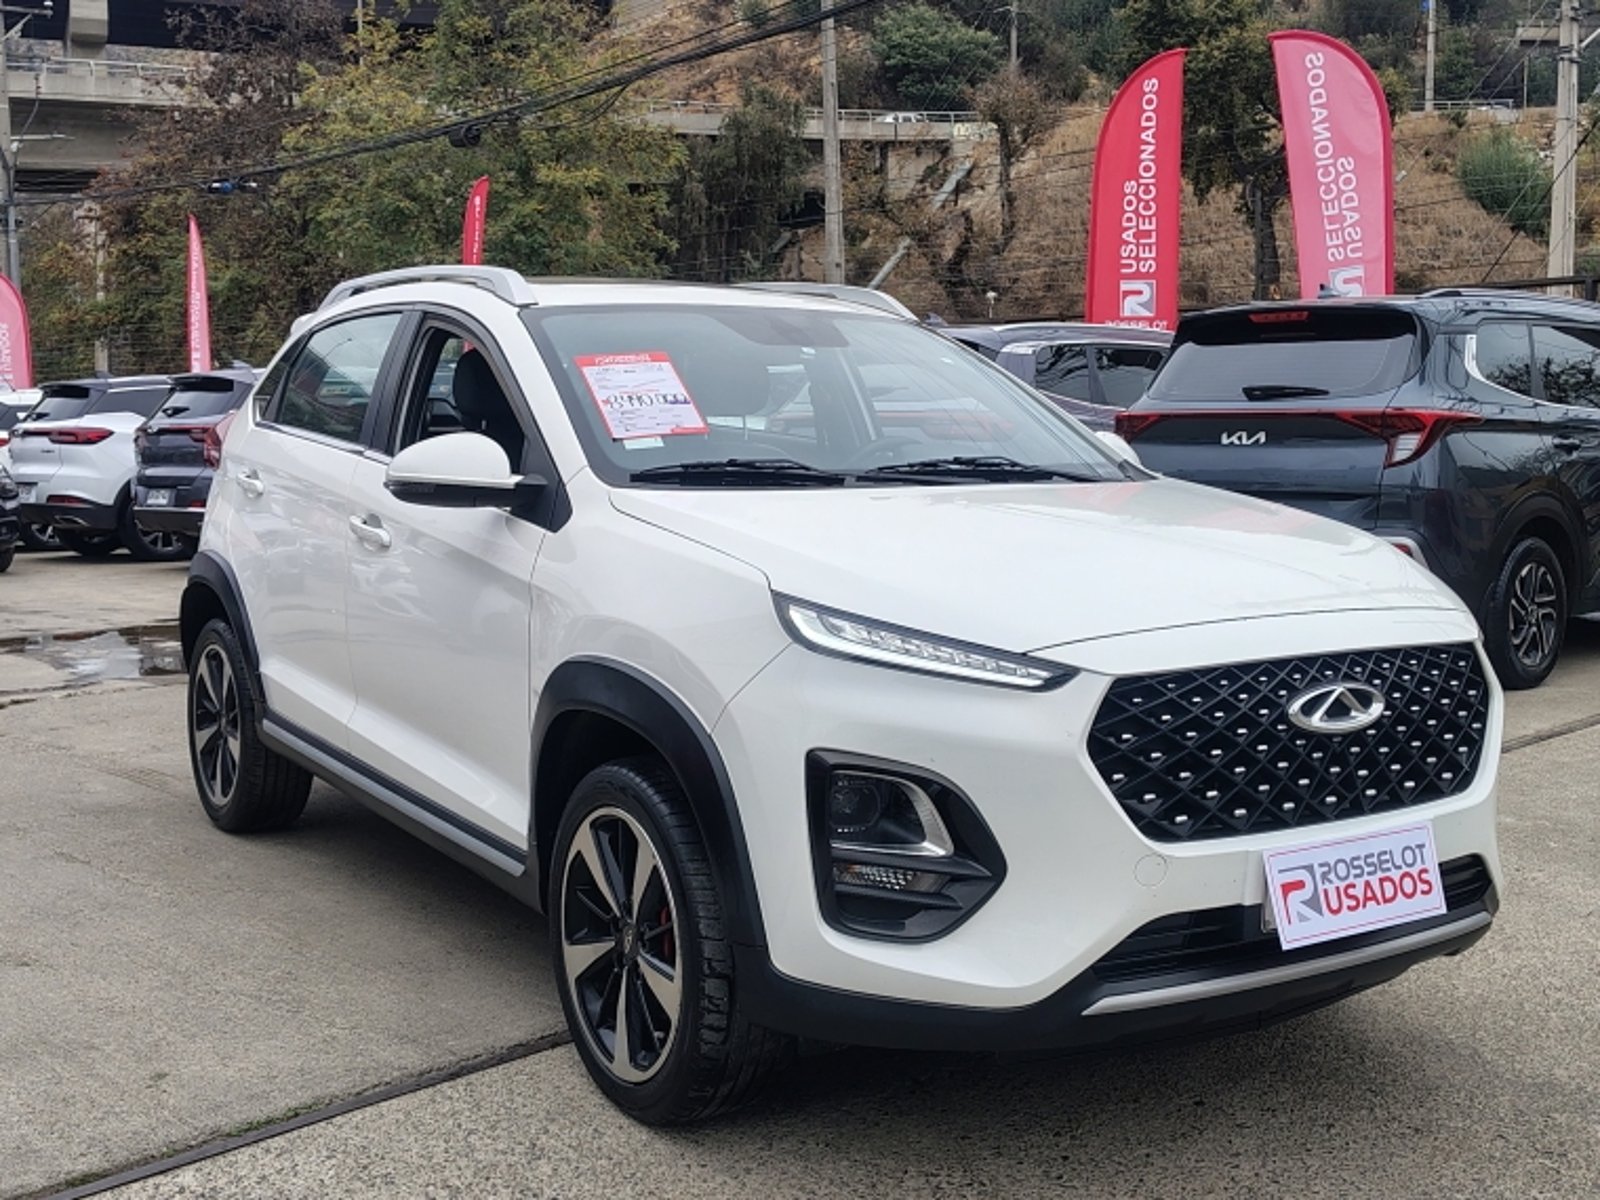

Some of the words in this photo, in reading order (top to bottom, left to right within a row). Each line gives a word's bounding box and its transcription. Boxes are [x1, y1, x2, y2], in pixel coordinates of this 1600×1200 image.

[1138, 77, 1159, 273] SELECCIONADOS
[1120, 180, 1137, 273] USADOS
[1220, 431, 1266, 445] KIA
[1317, 843, 1426, 885] ROSSELOT
[1322, 867, 1433, 916] USADOS
